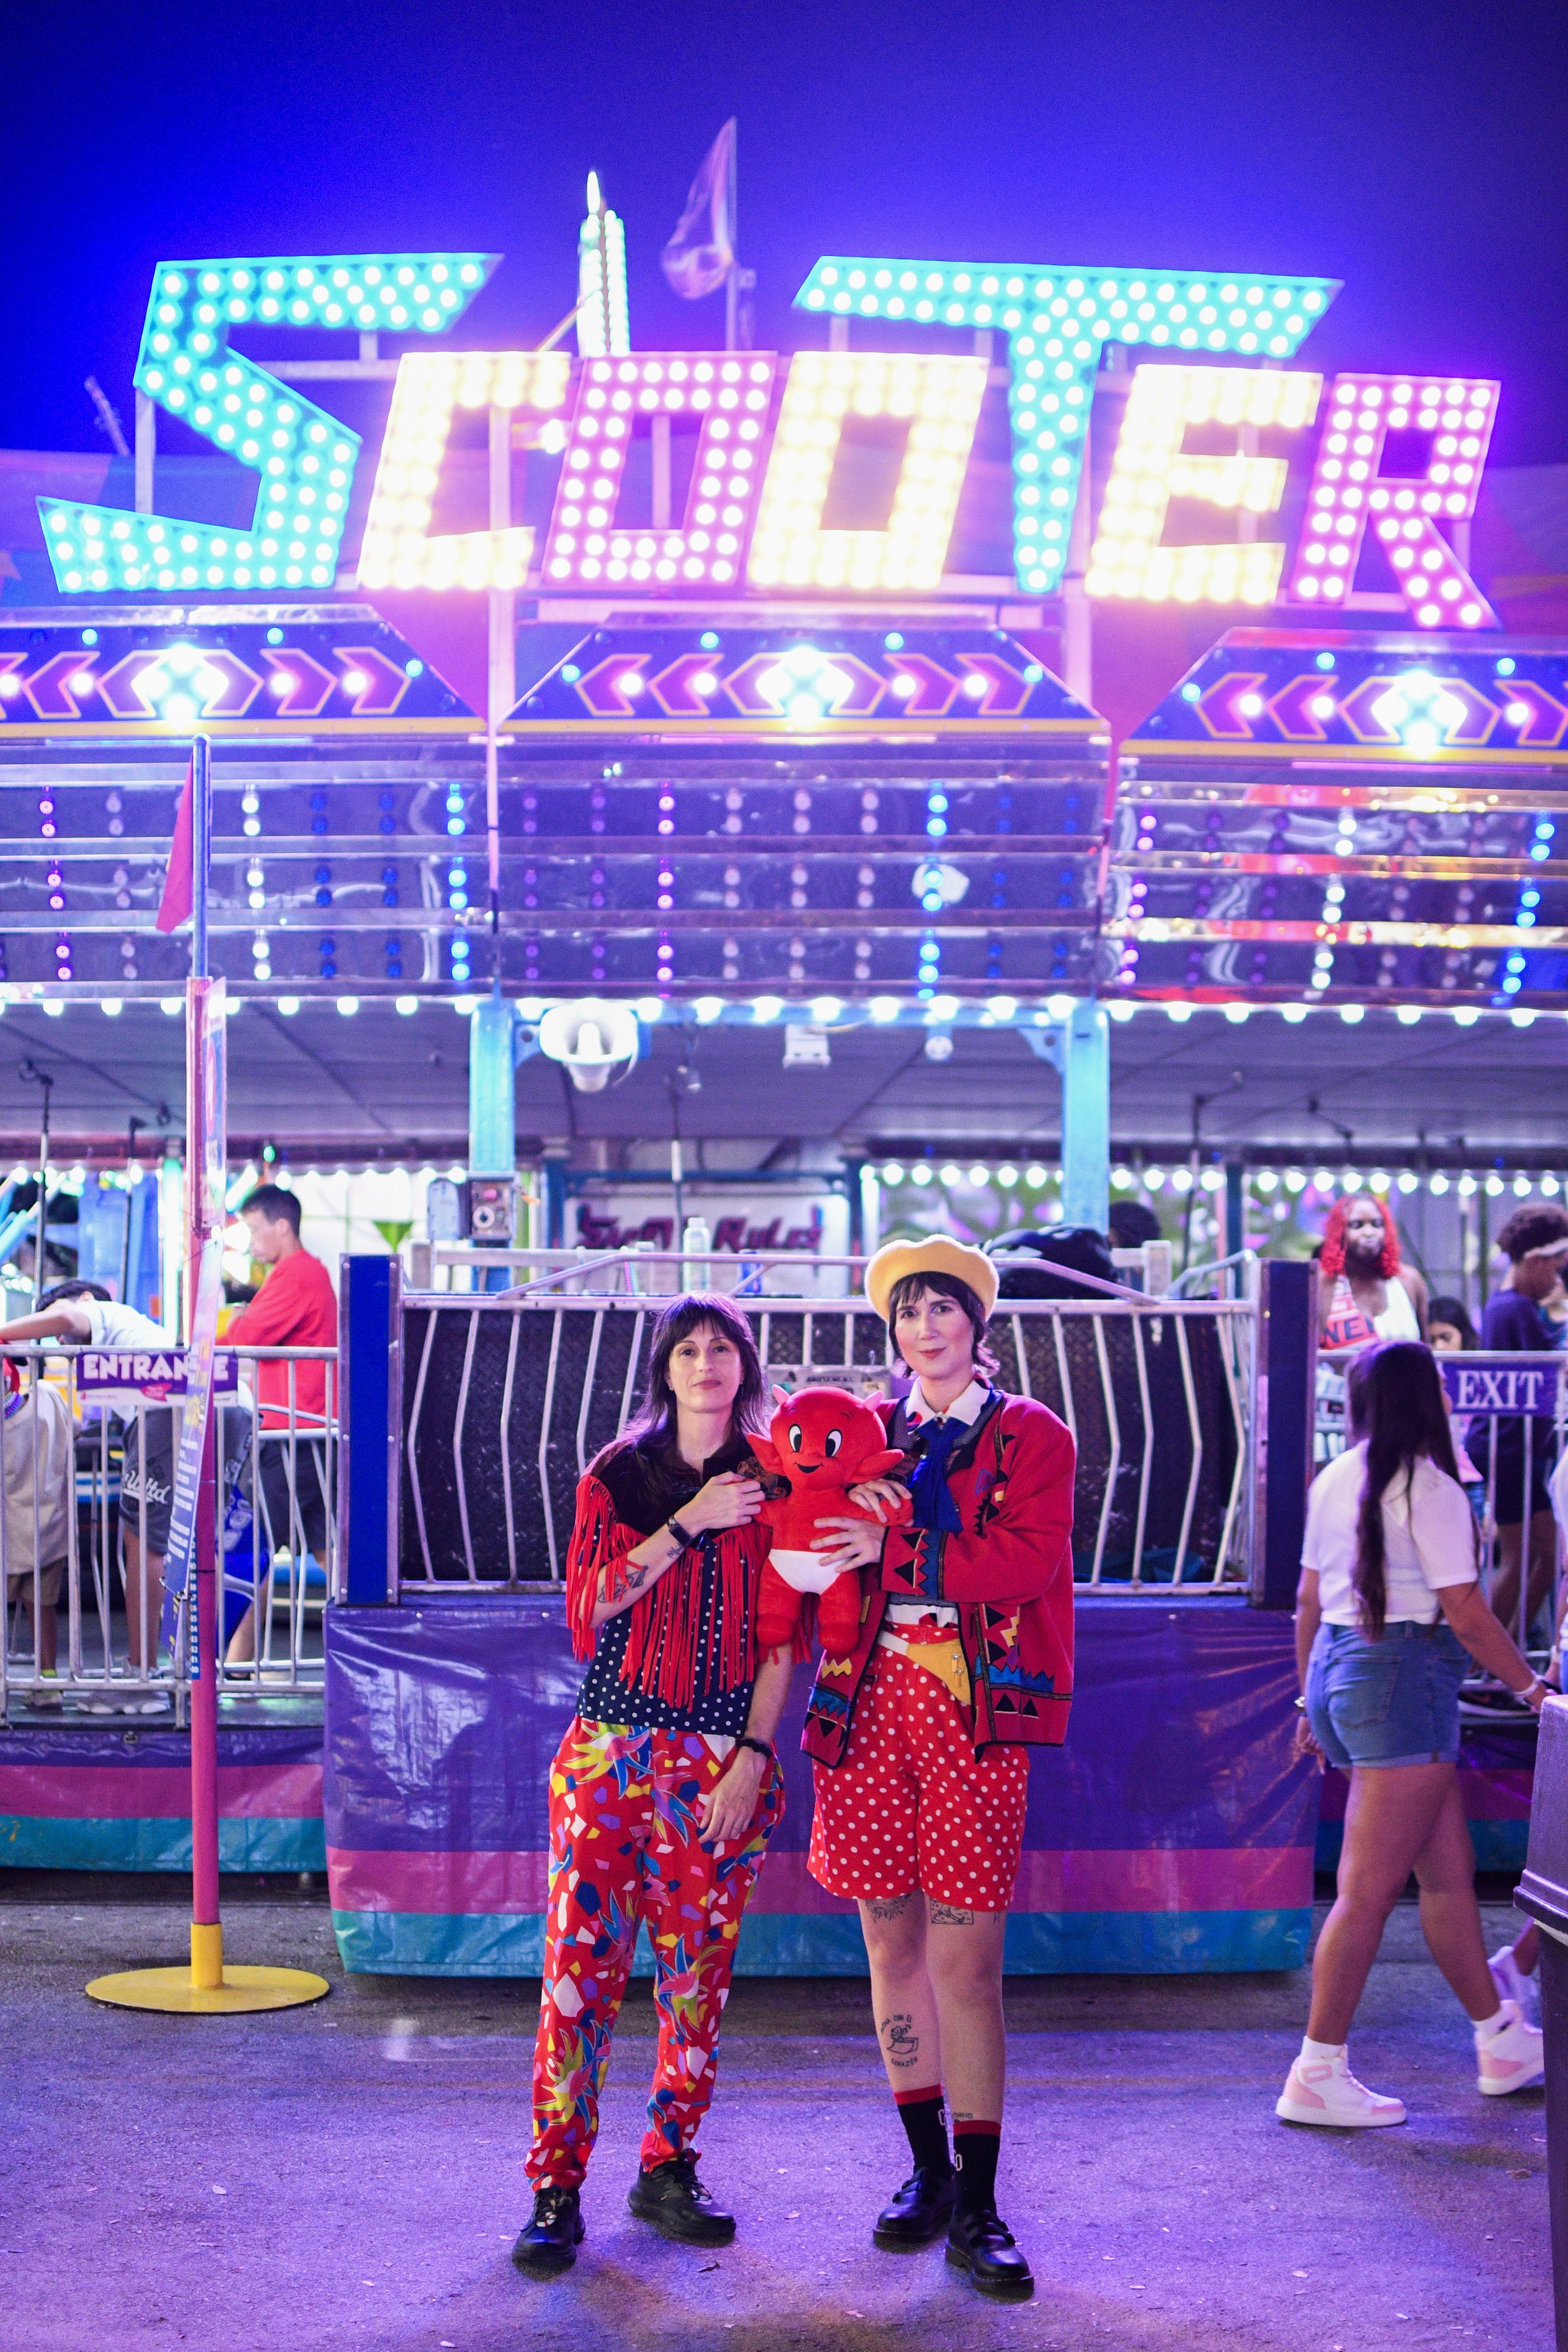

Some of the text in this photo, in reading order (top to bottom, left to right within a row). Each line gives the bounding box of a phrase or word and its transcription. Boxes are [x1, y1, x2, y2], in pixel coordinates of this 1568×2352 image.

[36, 253, 1502, 628] SCOOTER
[83, 1353, 229, 1381] ENTRANE
[1456, 1369, 1545, 1410] EXIT
